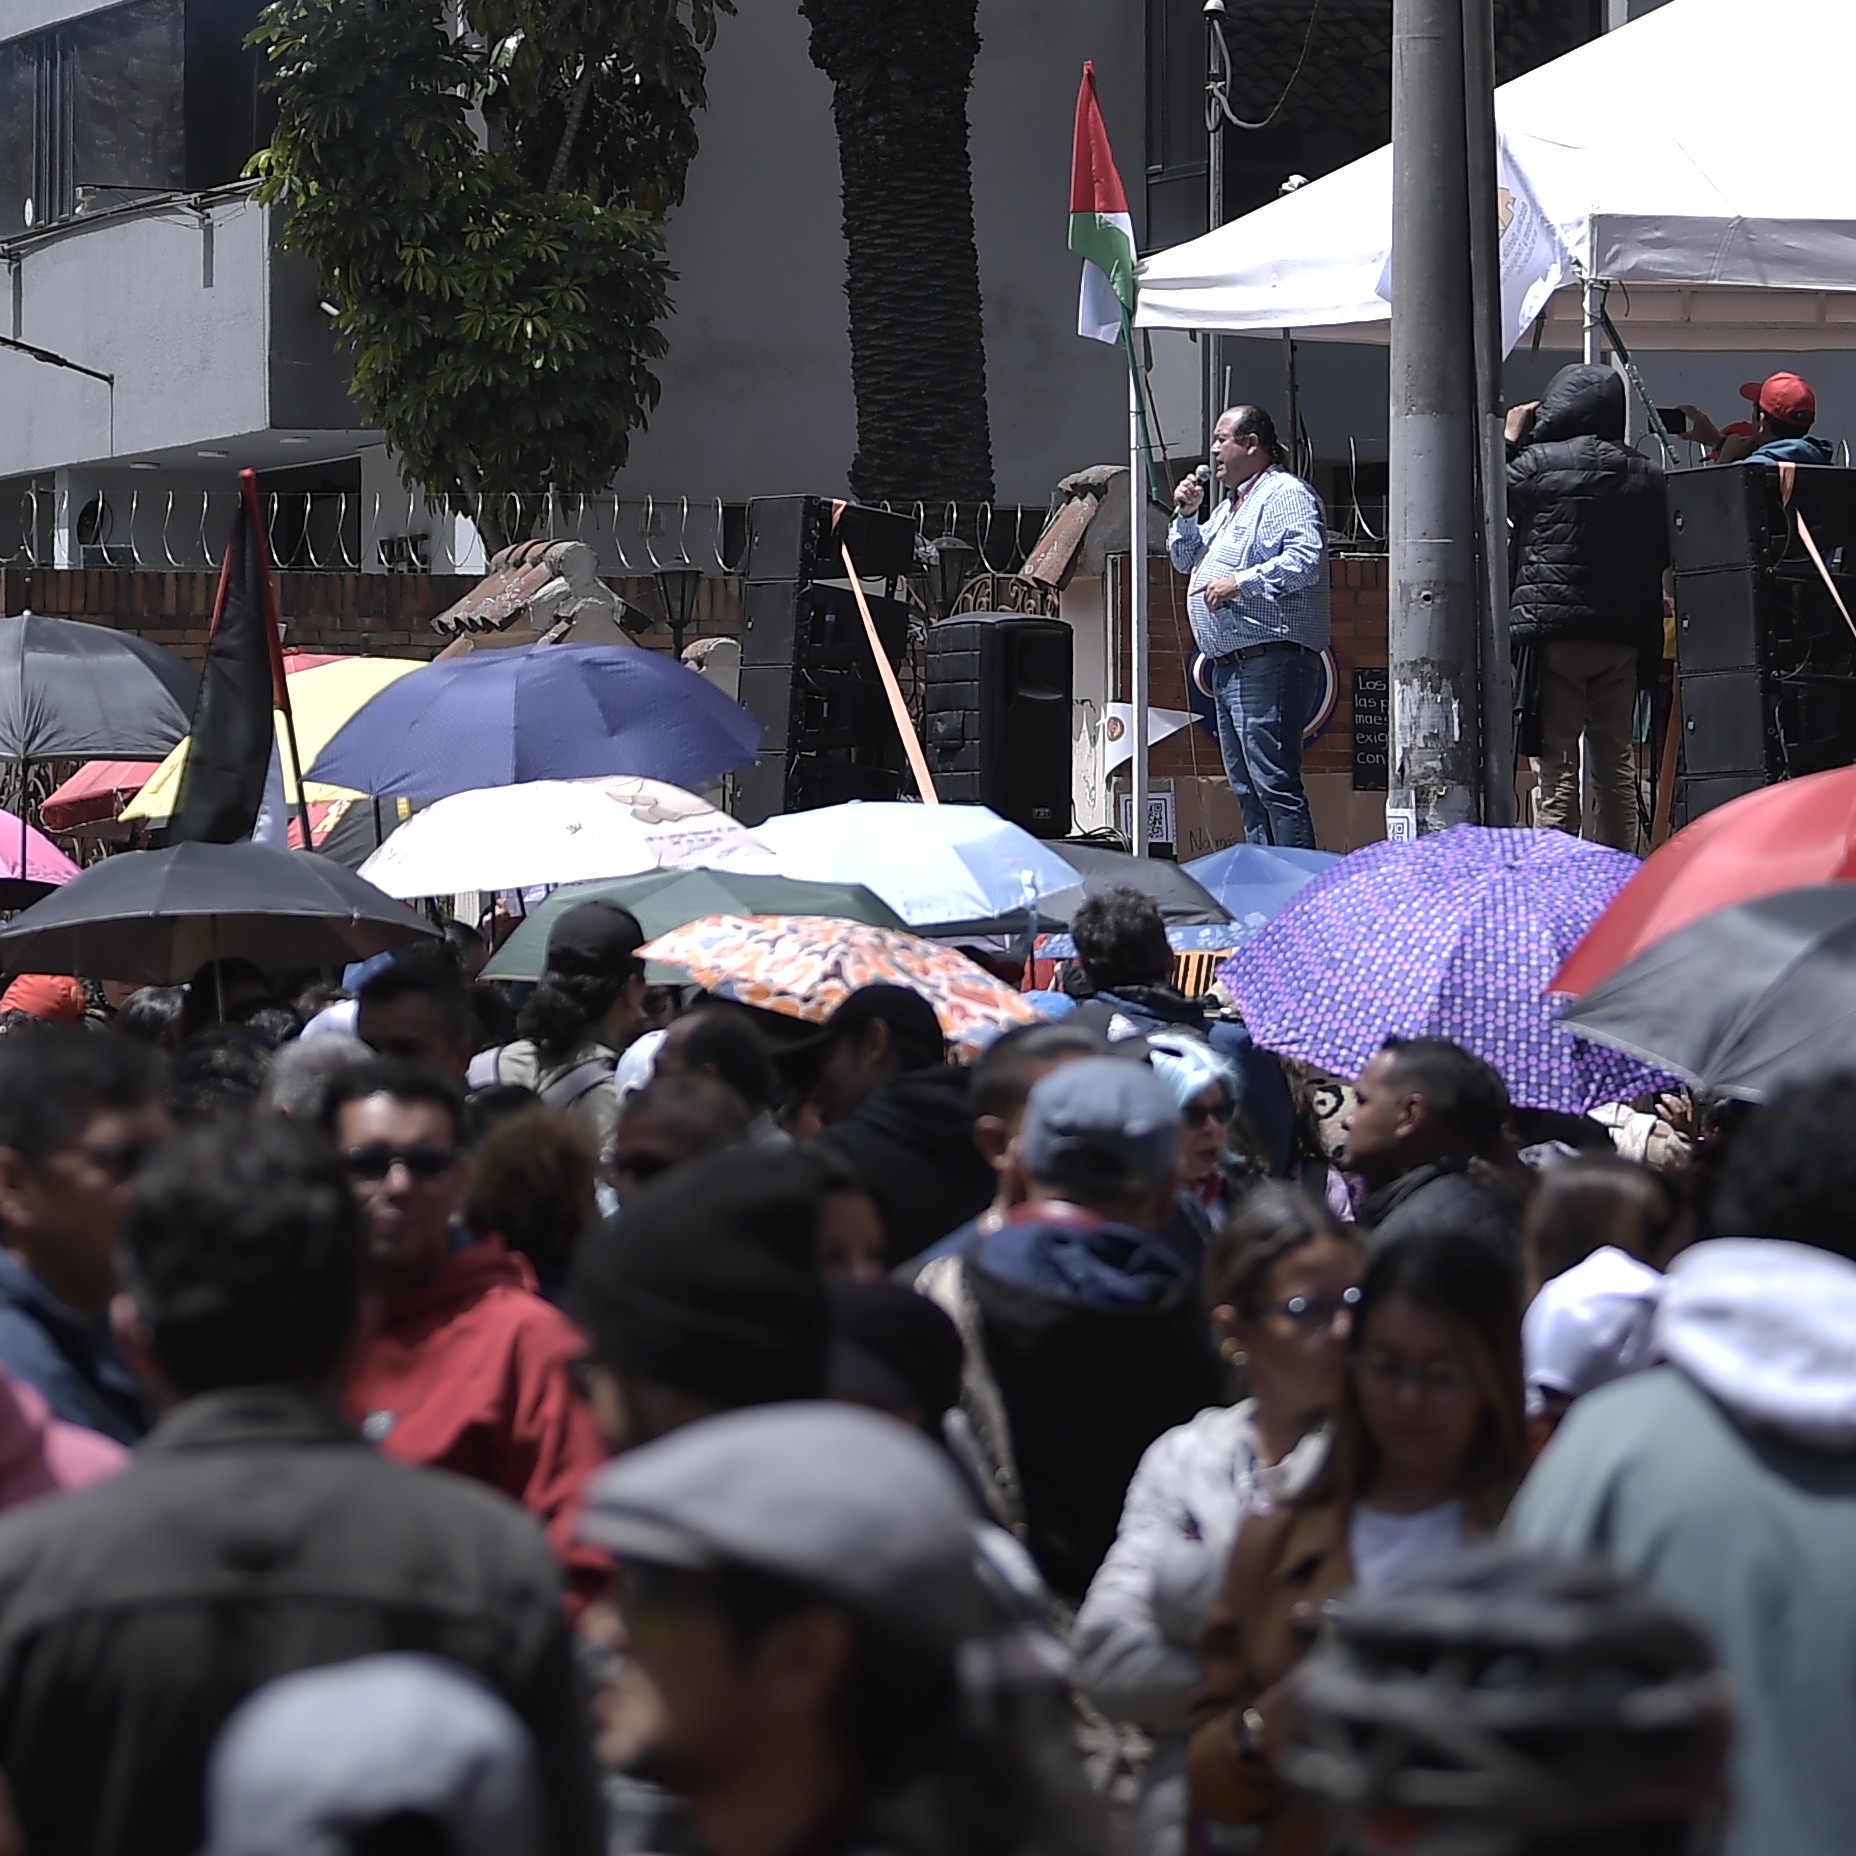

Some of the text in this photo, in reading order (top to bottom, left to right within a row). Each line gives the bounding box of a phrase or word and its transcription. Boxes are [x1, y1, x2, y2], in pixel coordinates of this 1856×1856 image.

[1358, 676, 1386, 691] Los
[1355, 695, 1376, 708] las
[1357, 751, 1386, 765] con
